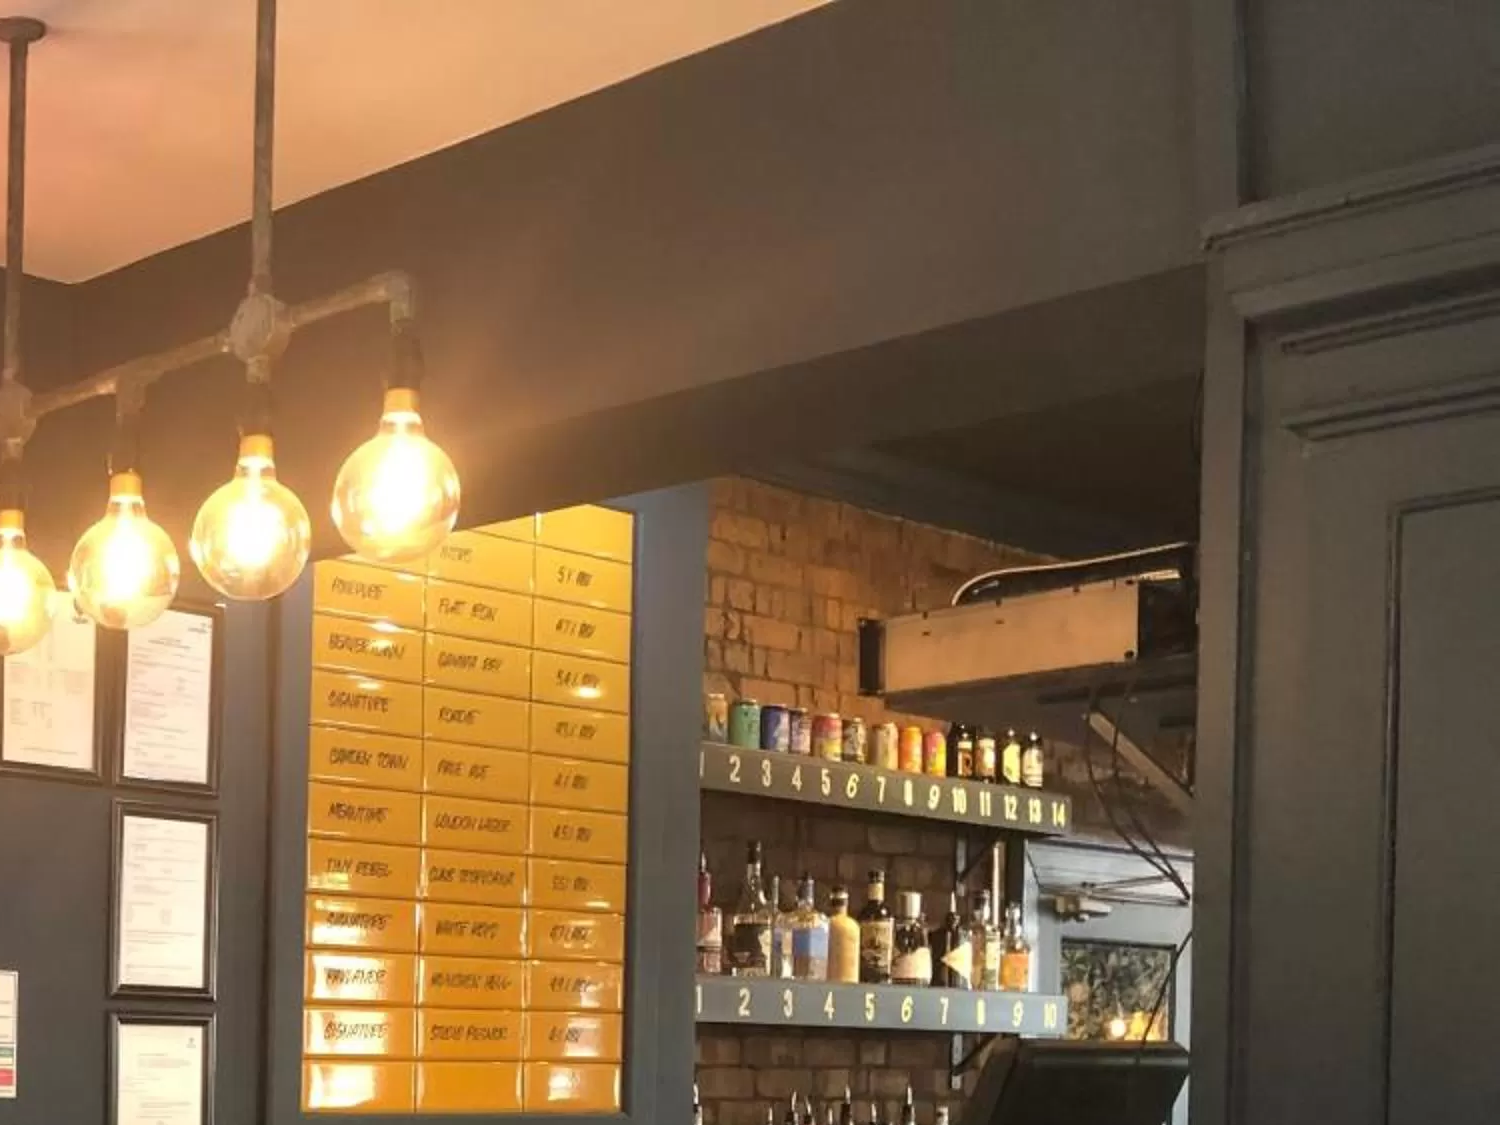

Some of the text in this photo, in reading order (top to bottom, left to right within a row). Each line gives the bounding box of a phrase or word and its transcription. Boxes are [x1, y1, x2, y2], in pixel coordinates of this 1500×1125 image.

[728, 755, 741, 783] 2
[762, 759, 772, 787] 3
[791, 765, 803, 792] 4
[821, 768, 831, 796] 5
[846, 773, 860, 799] 6
[876, 776, 887, 803] 7
[928, 784, 941, 810] 9
[951, 786, 967, 815] 10
[979, 790, 992, 817] 11
[1004, 794, 1017, 820] 12
[1028, 797, 1042, 824] 13
[1051, 801, 1066, 828] 14
[695, 984, 703, 1014] 1
[738, 987, 750, 1017] 2
[783, 988, 793, 1018] 3
[823, 991, 835, 1020] 4
[864, 992, 876, 1022] 5
[901, 995, 914, 1023] 6
[939, 996, 949, 1025] 7
[1011, 1000, 1024, 1027] 9
[1043, 1002, 1058, 1029] 10
